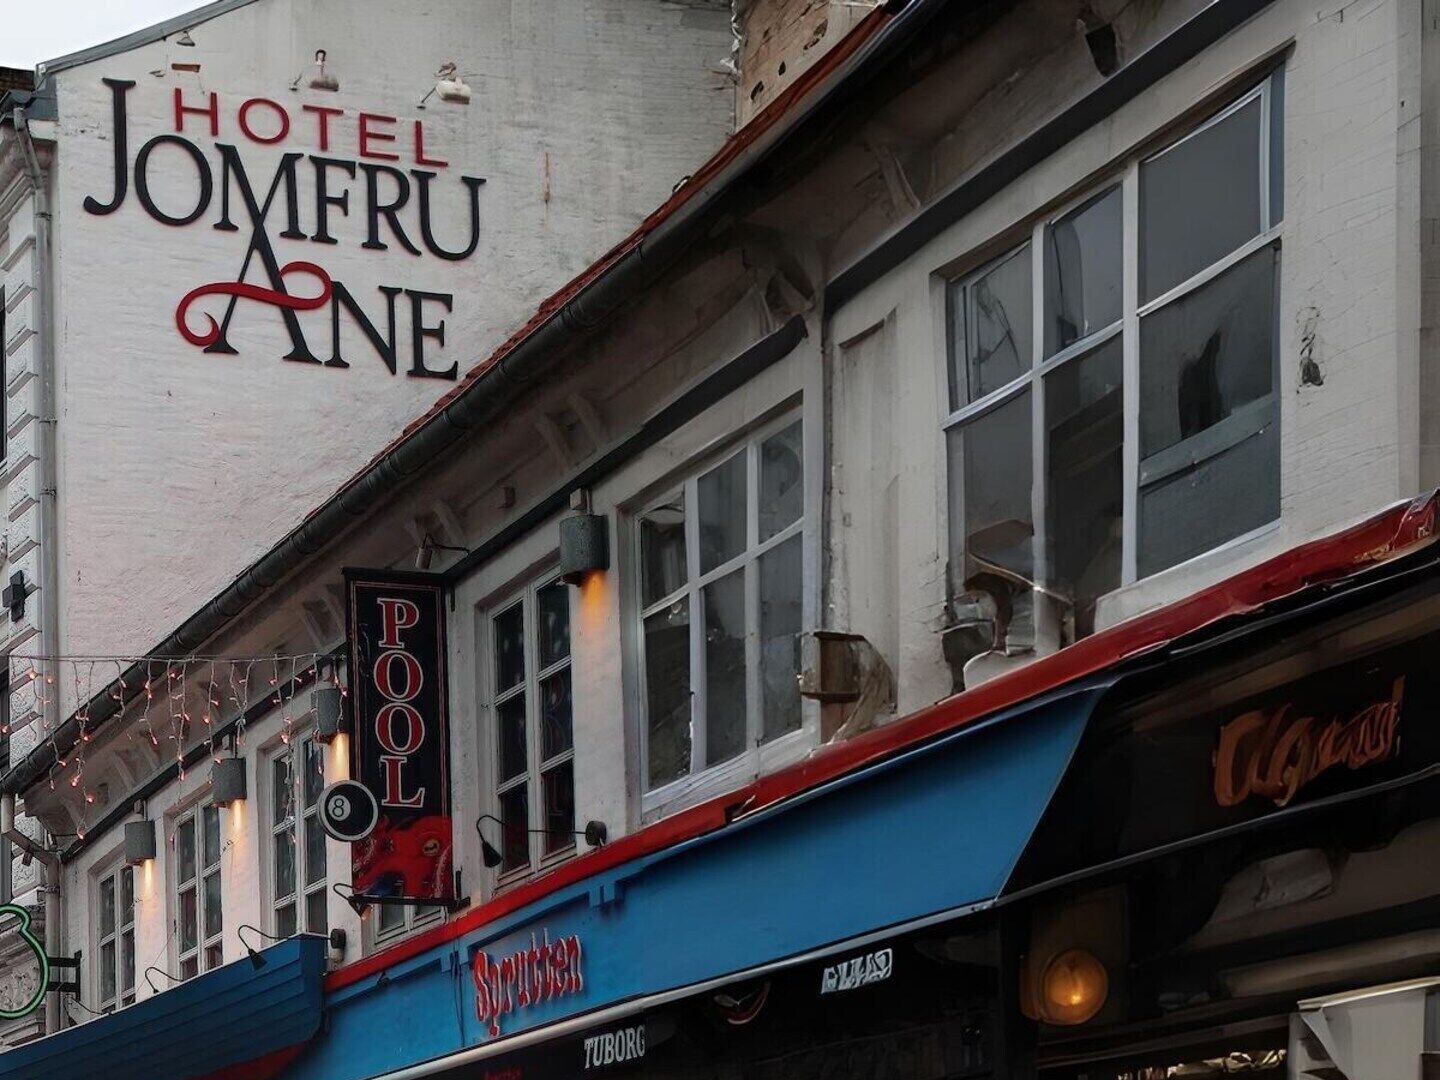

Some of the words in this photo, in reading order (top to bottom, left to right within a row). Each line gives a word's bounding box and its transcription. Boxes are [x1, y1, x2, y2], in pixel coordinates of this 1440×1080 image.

[83, 77, 487, 261] JOMFRU
[172, 87, 449, 167] HOTEL
[174, 216, 459, 381] ANE
[372, 598, 425, 808] POOL
[472, 928, 583, 1035] Sprutten
[584, 1024, 646, 1069] TUBORG
